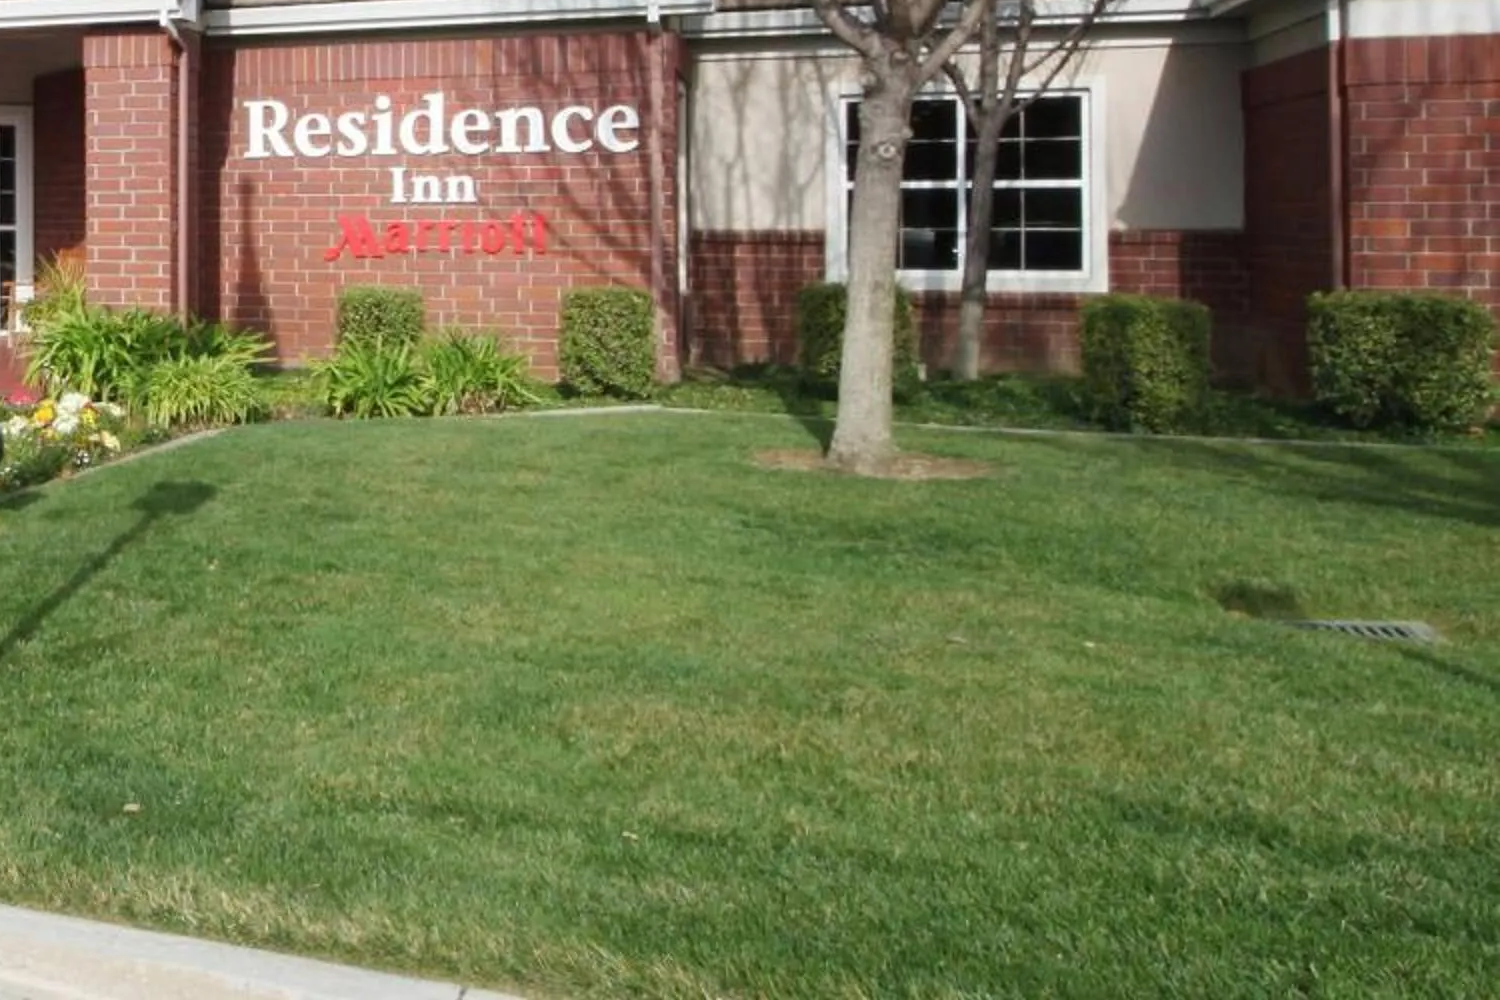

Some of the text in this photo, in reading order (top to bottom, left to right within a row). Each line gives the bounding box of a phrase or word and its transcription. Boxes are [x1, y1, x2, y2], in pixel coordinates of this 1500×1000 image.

[243, 91, 640, 159] Residence
[389, 165, 477, 204] Inn
[324, 213, 547, 262] Marriott
